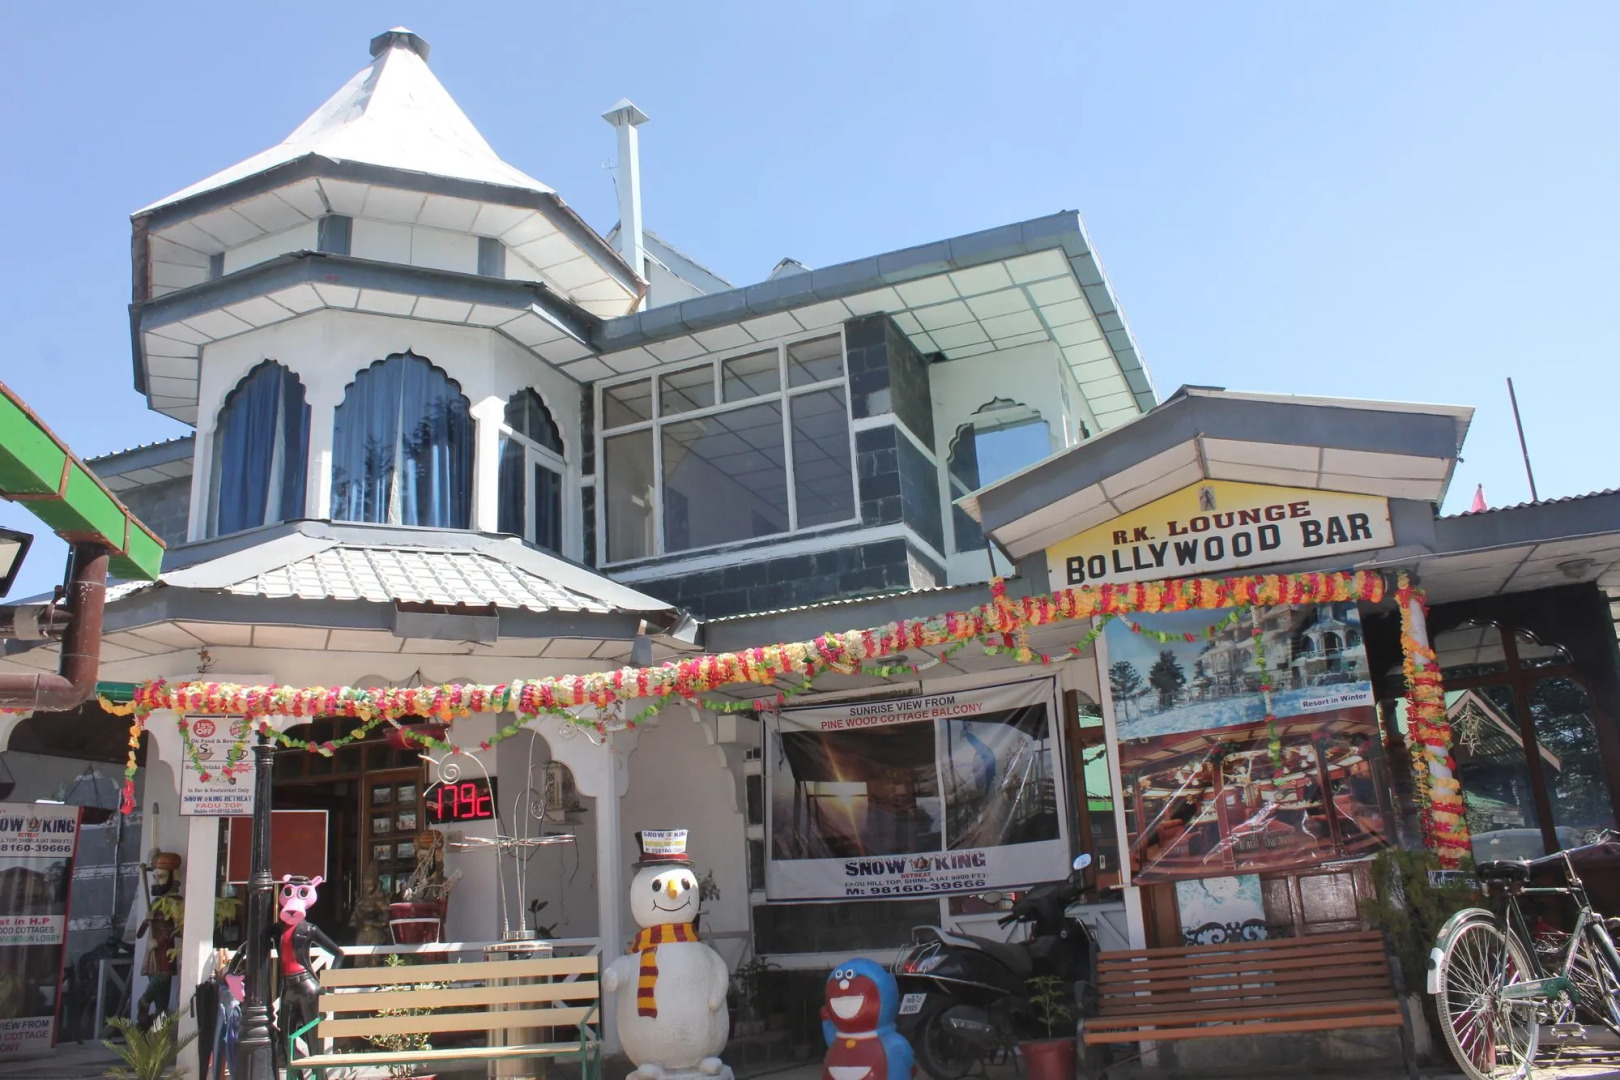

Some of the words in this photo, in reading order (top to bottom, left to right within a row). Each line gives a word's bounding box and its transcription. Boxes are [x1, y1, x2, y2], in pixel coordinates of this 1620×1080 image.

[1113, 526, 1155, 545] R.K.
[1168, 500, 1311, 537] LOUNGE
[1066, 523, 1282, 585] BOLLYWOOD
[1300, 512, 1372, 548] BAR
[849, 703, 894, 716] SUNRISE
[896, 699, 922, 711] VIEW
[925, 696, 955, 707] FROM
[1302, 699, 1329, 708] Resort
[1340, 693, 1367, 702] Winter
[820, 719, 844, 730] PINE
[845, 716, 877, 728] WOOD
[880, 711, 929, 723] COTTAGE
[932, 703, 983, 717] BALCONY
[42, 816, 76, 833] KING
[844, 858, 907, 876] SNOW
[933, 851, 986, 872] KING
[845, 887, 866, 896] M:
[870, 879, 986, 895] 98160-39666
[936, 875, 949, 883] (AT
[36, 934, 60, 942] LOBBY
[22, 1020, 49, 1029] FROM
[4, 1030, 49, 1040] COTTAGE
